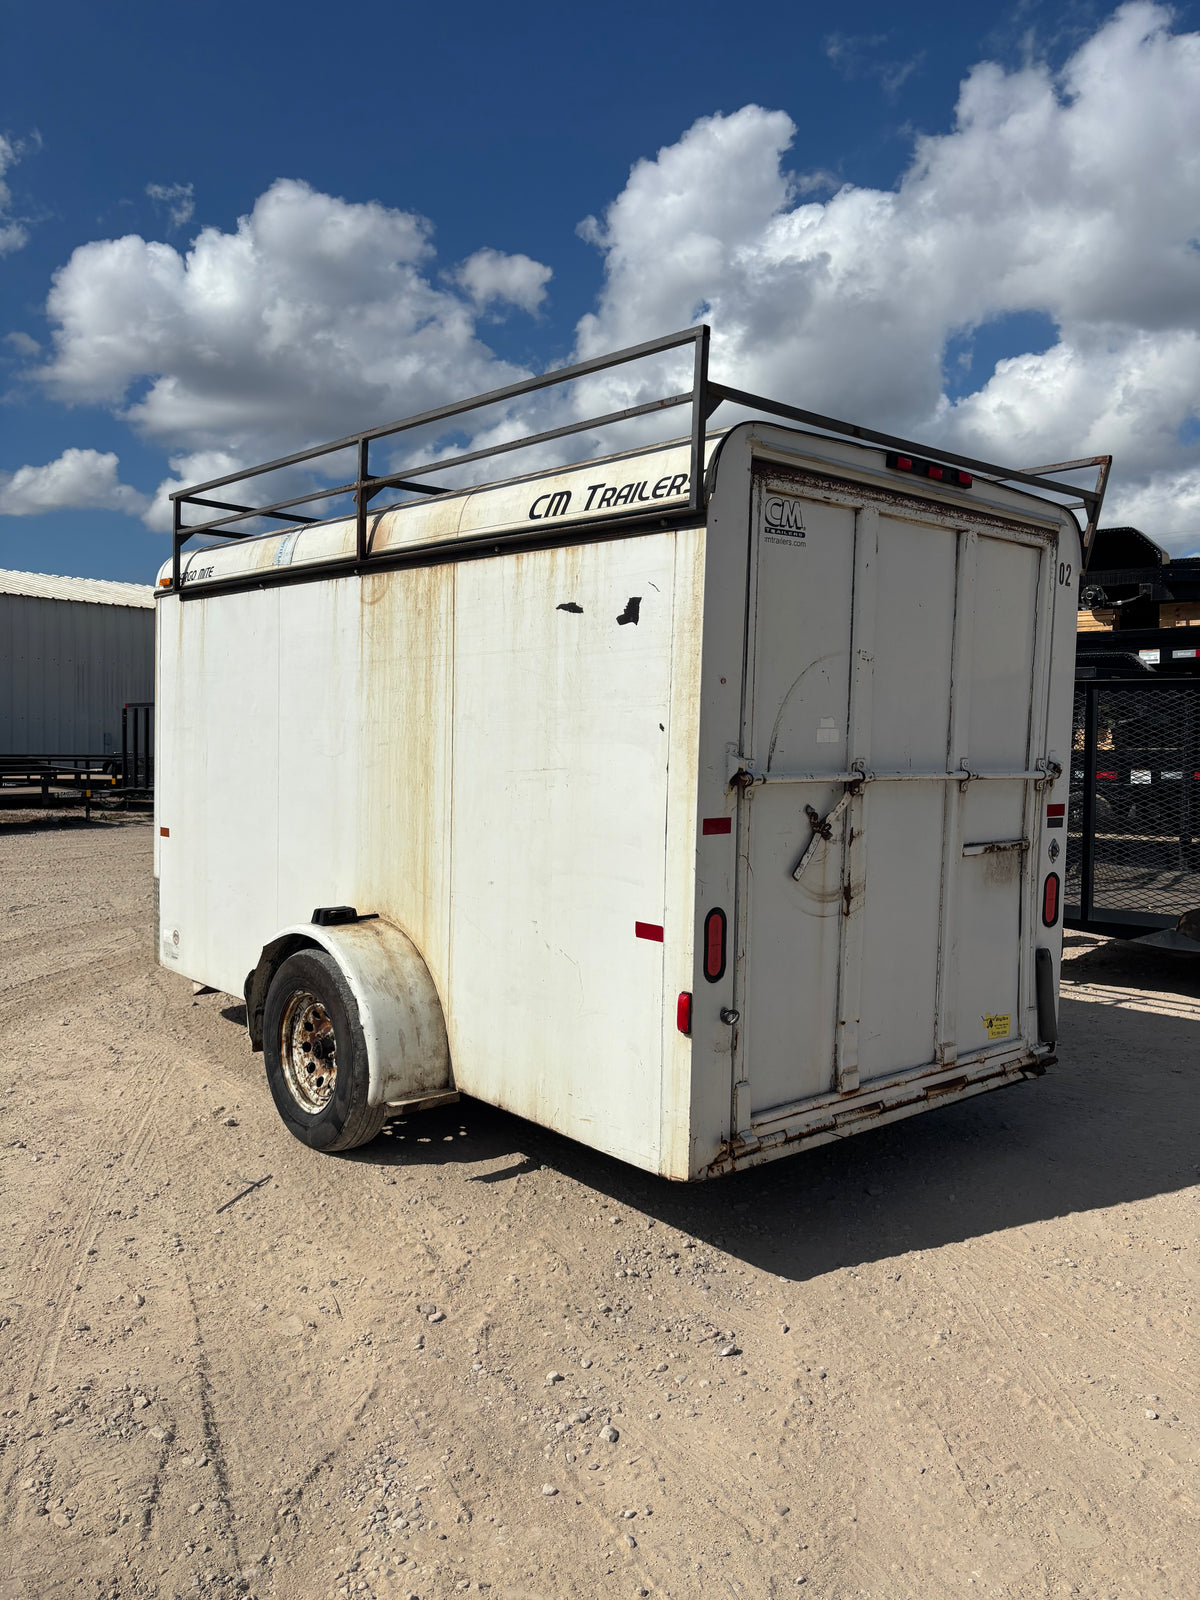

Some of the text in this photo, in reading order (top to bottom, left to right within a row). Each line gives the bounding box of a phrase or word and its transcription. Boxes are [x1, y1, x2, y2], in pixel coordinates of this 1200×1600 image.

[529, 490, 572, 520] CM
[765, 497, 804, 530] CM
[1059, 562, 1071, 587] 02
